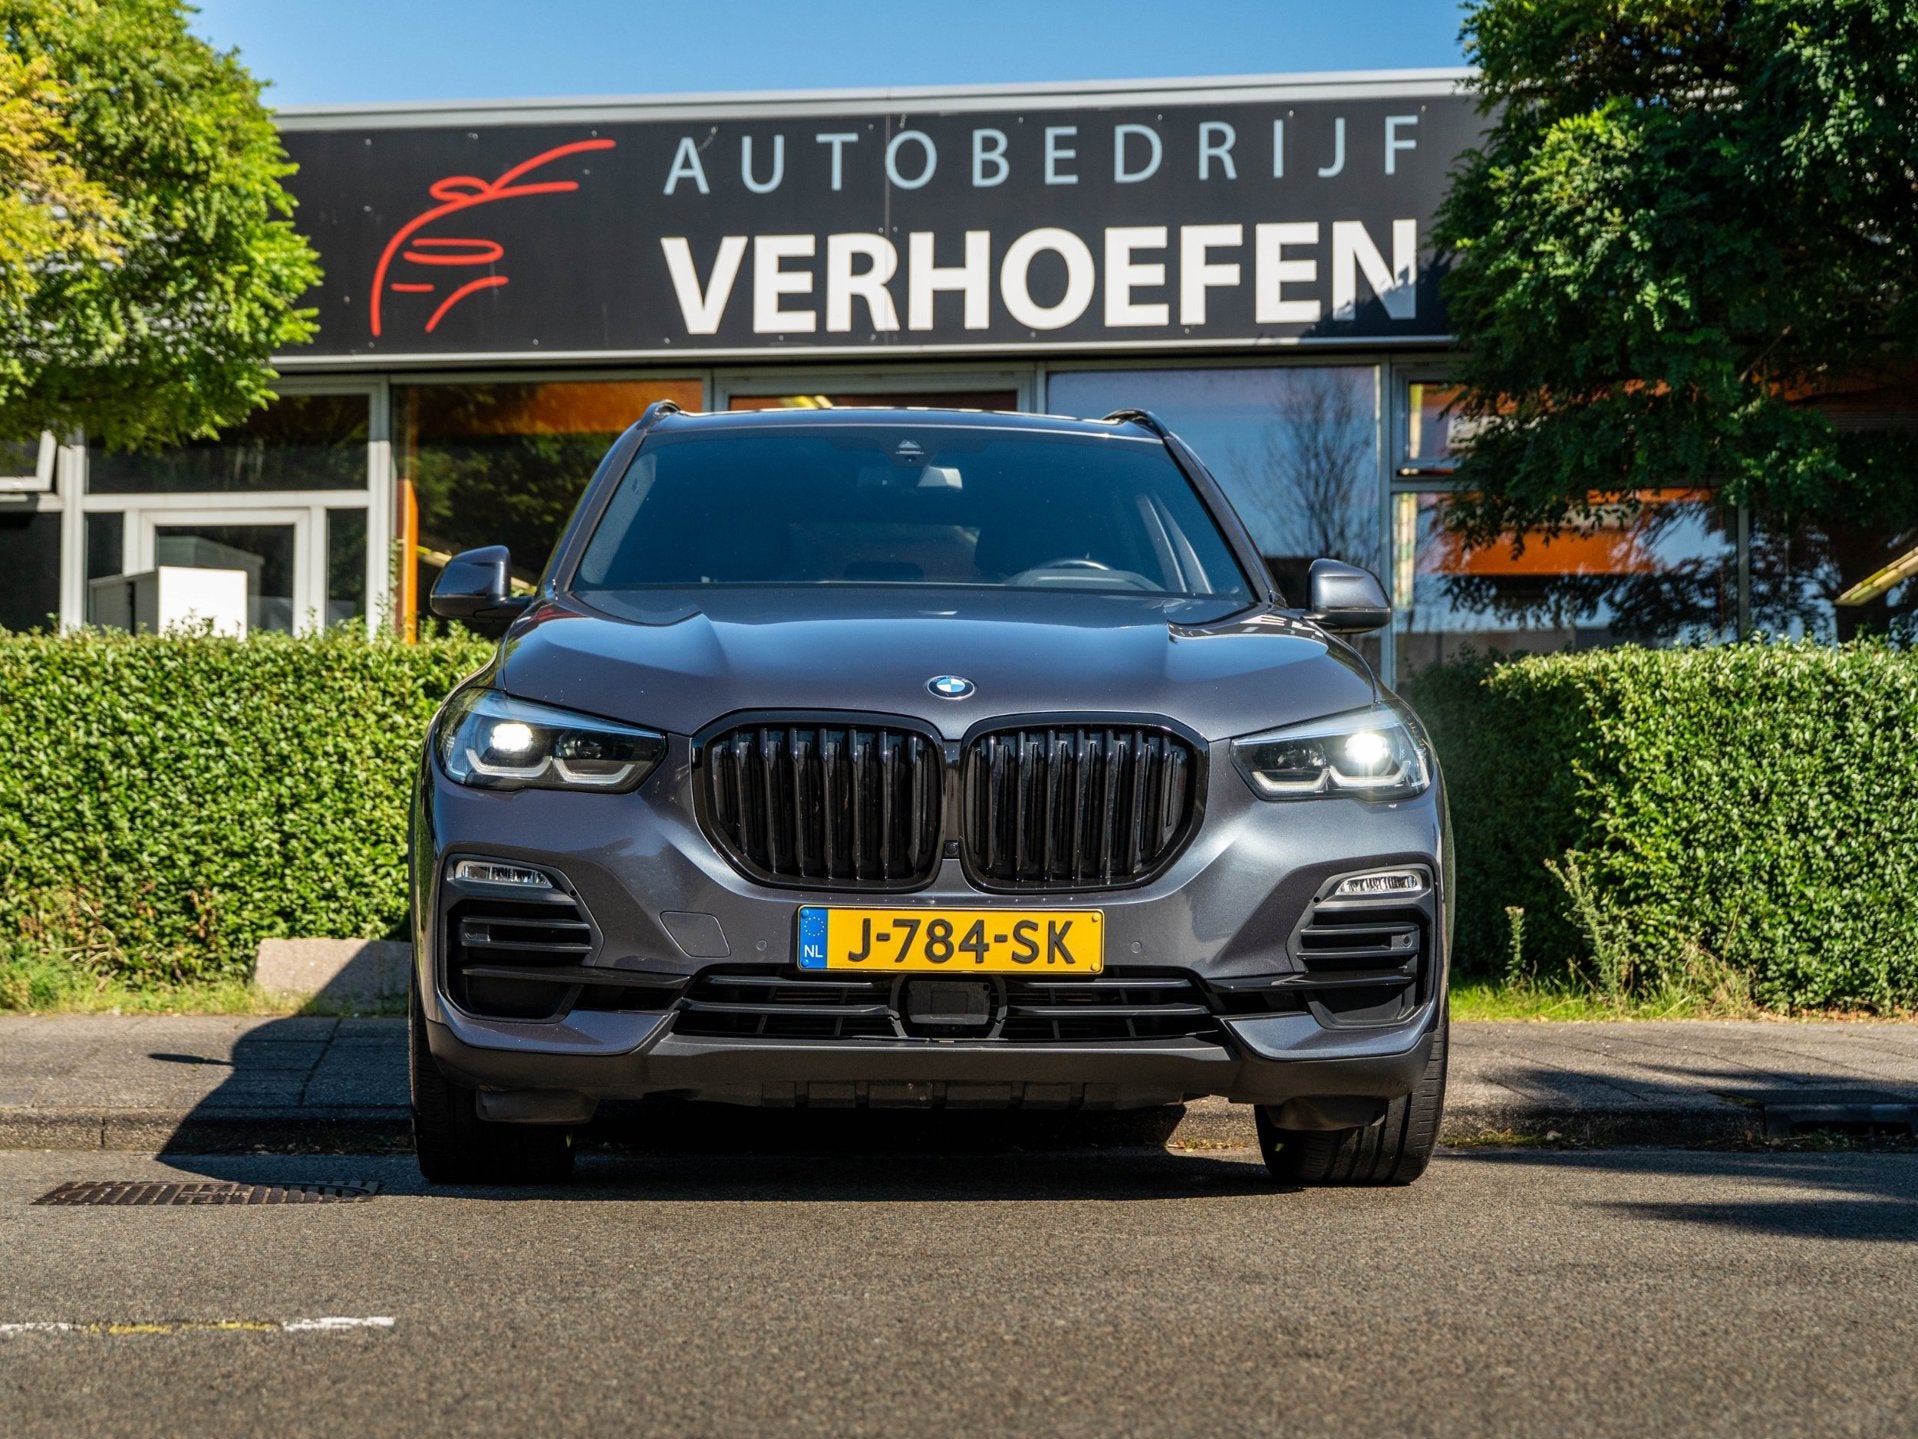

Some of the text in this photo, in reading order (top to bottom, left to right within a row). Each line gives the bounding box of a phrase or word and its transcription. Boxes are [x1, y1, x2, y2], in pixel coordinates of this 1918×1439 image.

[663, 115, 1419, 195] AUTOBEDRIJF
[661, 219, 1417, 334] VERHOEFEN
[804, 944, 823, 958] NL
[848, 918, 1076, 964] J-784-SK
